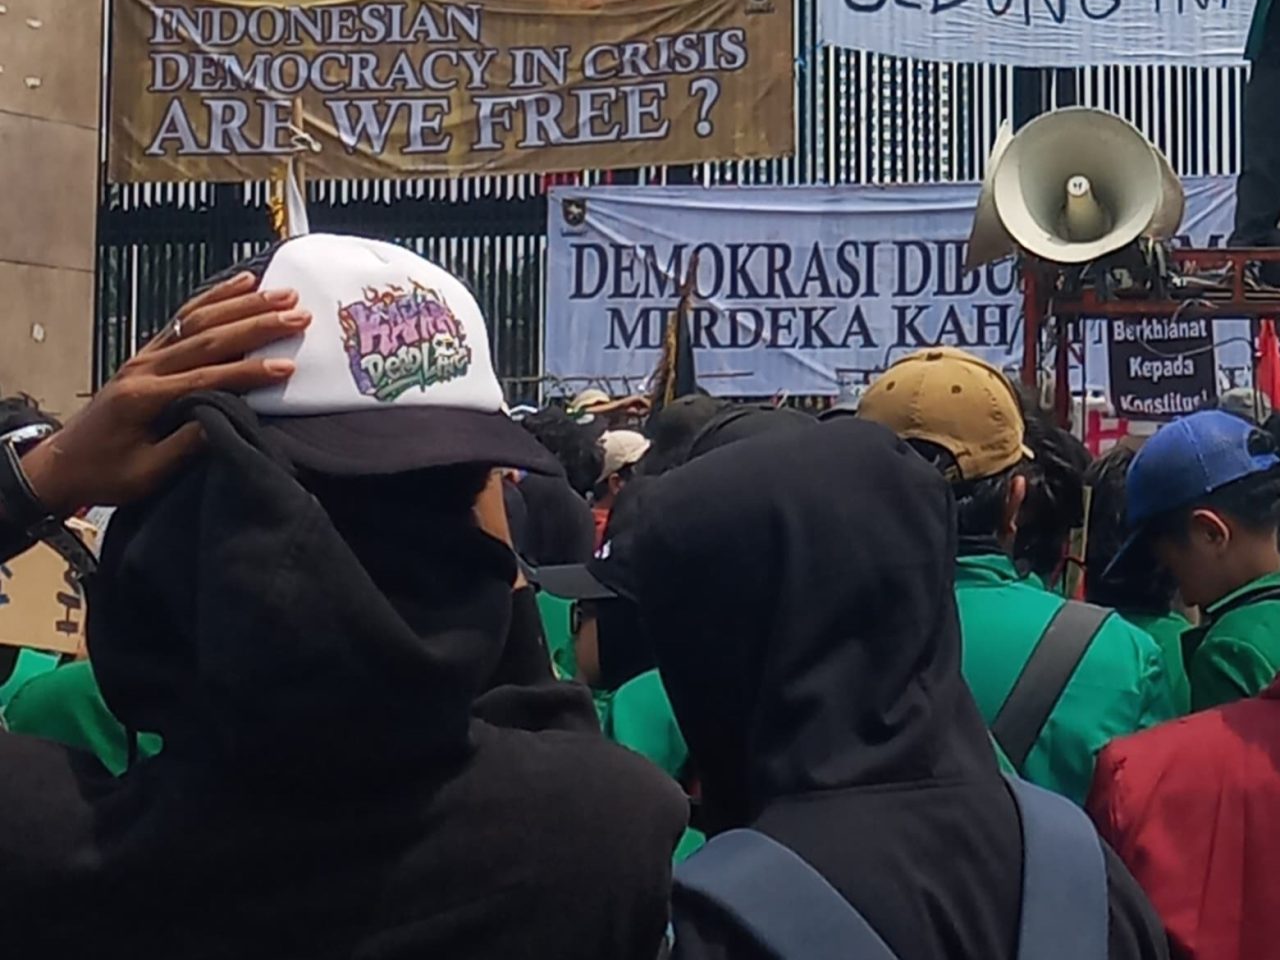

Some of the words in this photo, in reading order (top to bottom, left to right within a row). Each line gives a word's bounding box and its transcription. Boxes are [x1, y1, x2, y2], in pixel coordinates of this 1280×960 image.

[148, 2, 483, 46] INDONESIAN
[147, 47, 499, 94] DEMOCRACY
[509, 45, 570, 89] IN
[583, 26, 750, 81] CRISIS
[144, 96, 304, 157] ARE
[324, 96, 453, 156] WE
[471, 78, 671, 153] FREE
[688, 73, 721, 138] ?
[569, 239, 879, 301] DEMOKRASI
[891, 303, 1014, 347] KAH
[1129, 354, 1195, 383] Kepada
